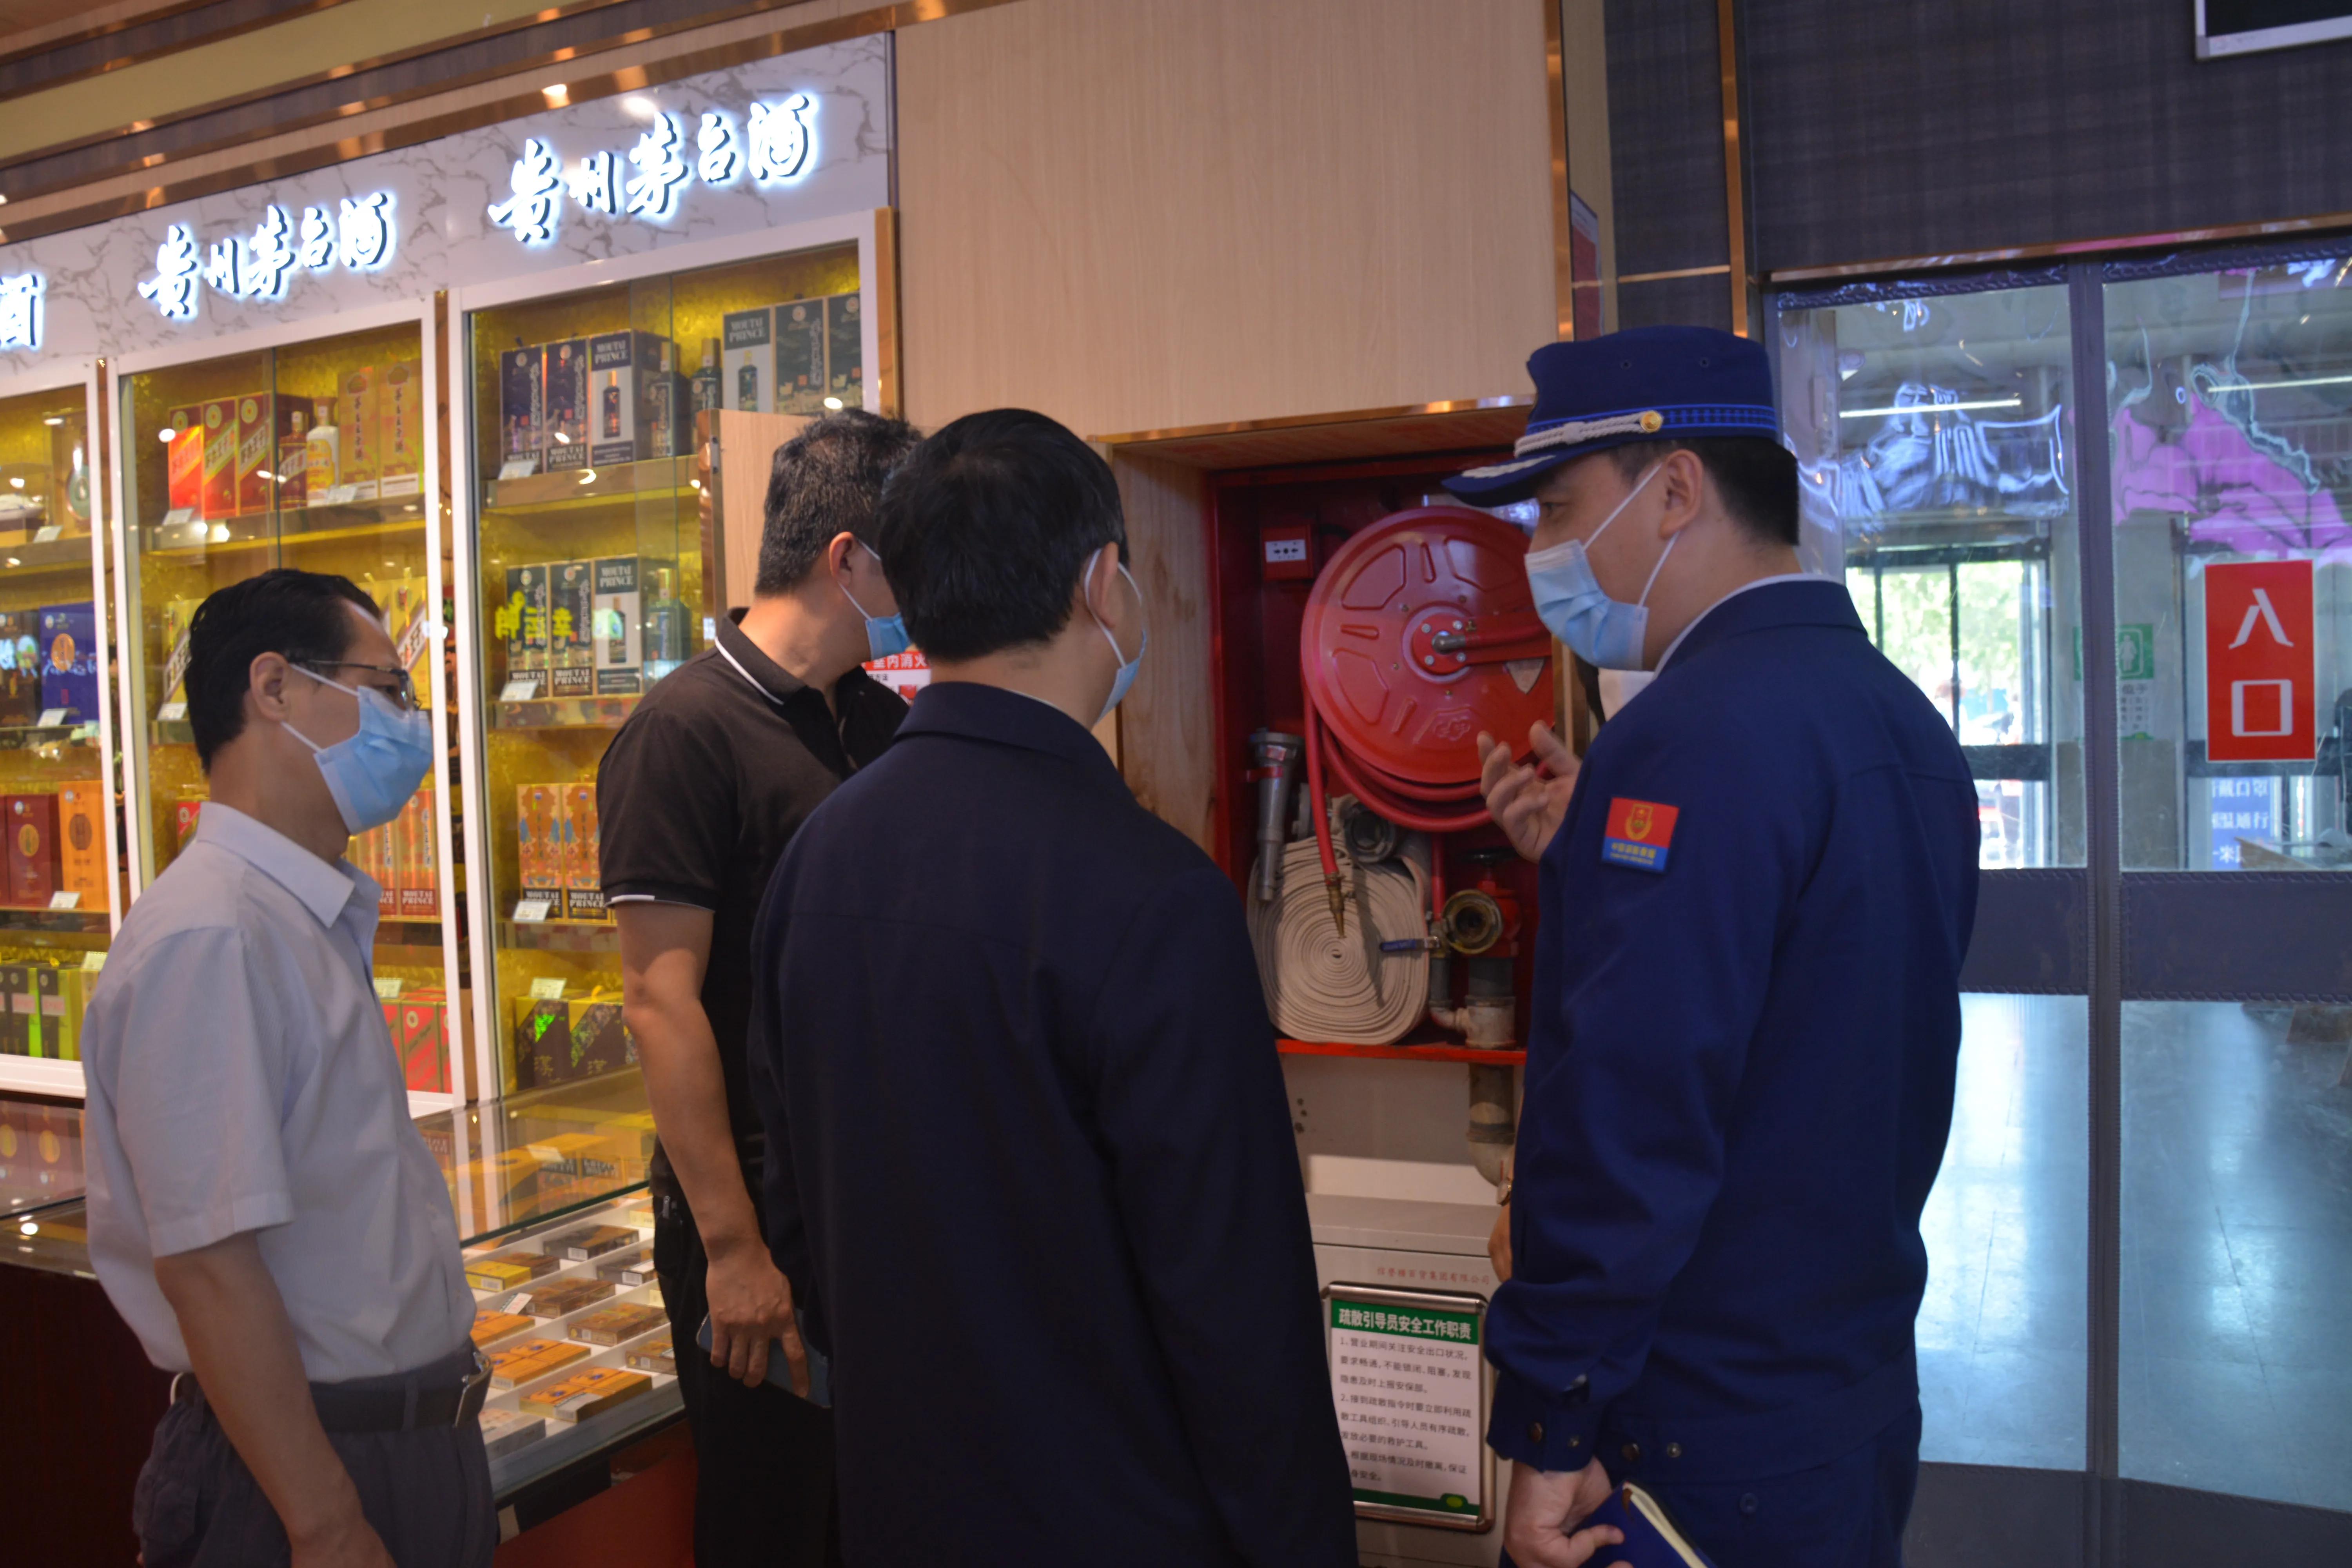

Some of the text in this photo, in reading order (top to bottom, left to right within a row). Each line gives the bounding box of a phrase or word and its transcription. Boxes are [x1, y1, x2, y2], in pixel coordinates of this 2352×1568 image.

[488, 94, 809, 241] 贵州茅台酒
[138, 193, 389, 317] 贵州茅台酒
[729, 328, 766, 343] PRINCE
[595, 350, 628, 365] PRINCE
[601, 565, 632, 577] MOUTAI
[600, 577, 633, 588] PRINCE
[2229, 588, 2294, 737] 入口
[555, 668, 590, 679] MOUTAI
[554, 677, 590, 686] PRINCE
[2212, 779, 2268, 797] 戴口罩
[2212, 811, 2269, 829] 温通行
[570, 898, 606, 908] PRINCE
[571, 891, 604, 900] MOUTAI
[1339, 1308, 1472, 1340] 疏散引导员安全工作职责
